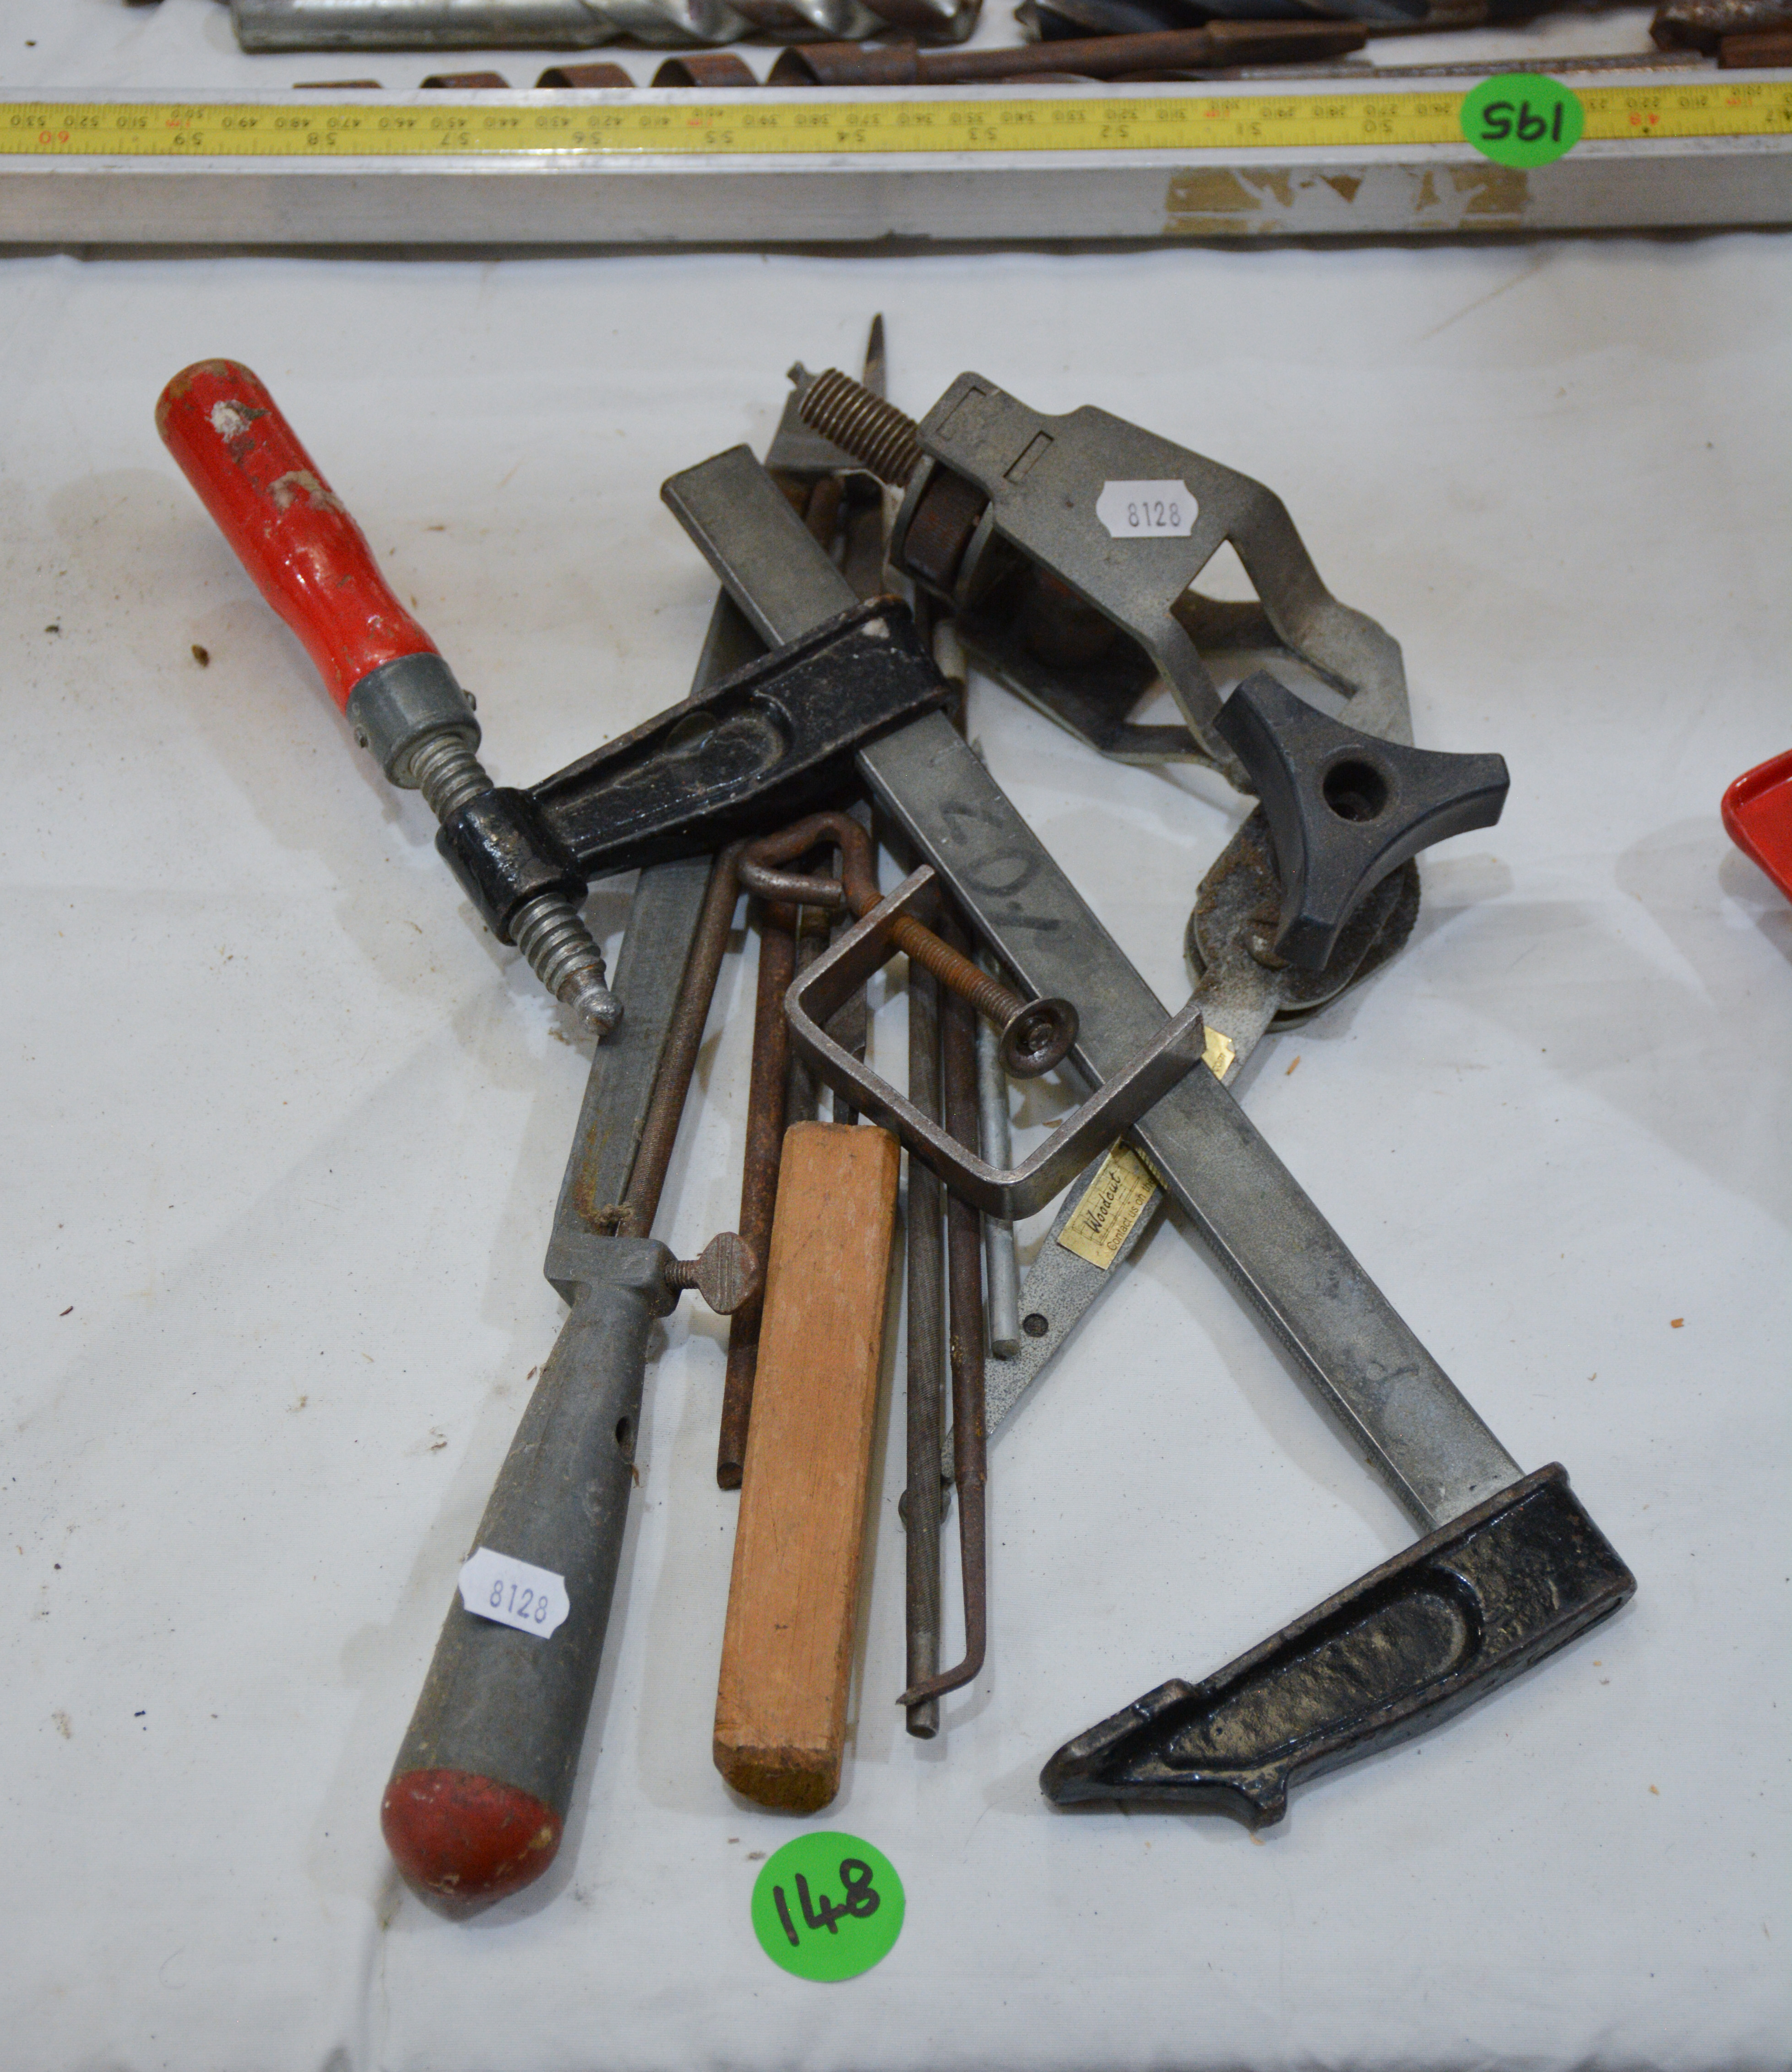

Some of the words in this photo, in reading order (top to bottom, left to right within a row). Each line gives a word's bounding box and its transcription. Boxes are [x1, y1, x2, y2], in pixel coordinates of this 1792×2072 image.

[116, 116, 148, 127] 510
[222, 116, 258, 128] 490
[275, 117, 310, 128] 480
[327, 116, 361, 128] 470
[1363, 119, 1393, 133] 50
[1481, 99, 1564, 142] 195
[39, 130, 70, 145] 60
[572, 131, 603, 145] 56
[706, 130, 733, 144] 55
[837, 129, 865, 142] 54
[969, 126, 998, 141] 53
[1101, 124, 1129, 138] 52
[174, 132, 204, 146] 59
[307, 132, 338, 146] 58
[440, 131, 471, 146] 57
[1128, 500, 1181, 527] 8128
[1083, 1171, 1121, 1234] Woodcut
[1107, 1216, 1134, 1251] Contact
[1129, 1206, 1139, 1218] us
[1135, 1193, 1146, 1206] on
[489, 1580, 548, 1624] 8128
[773, 1858, 880, 1946] 148
